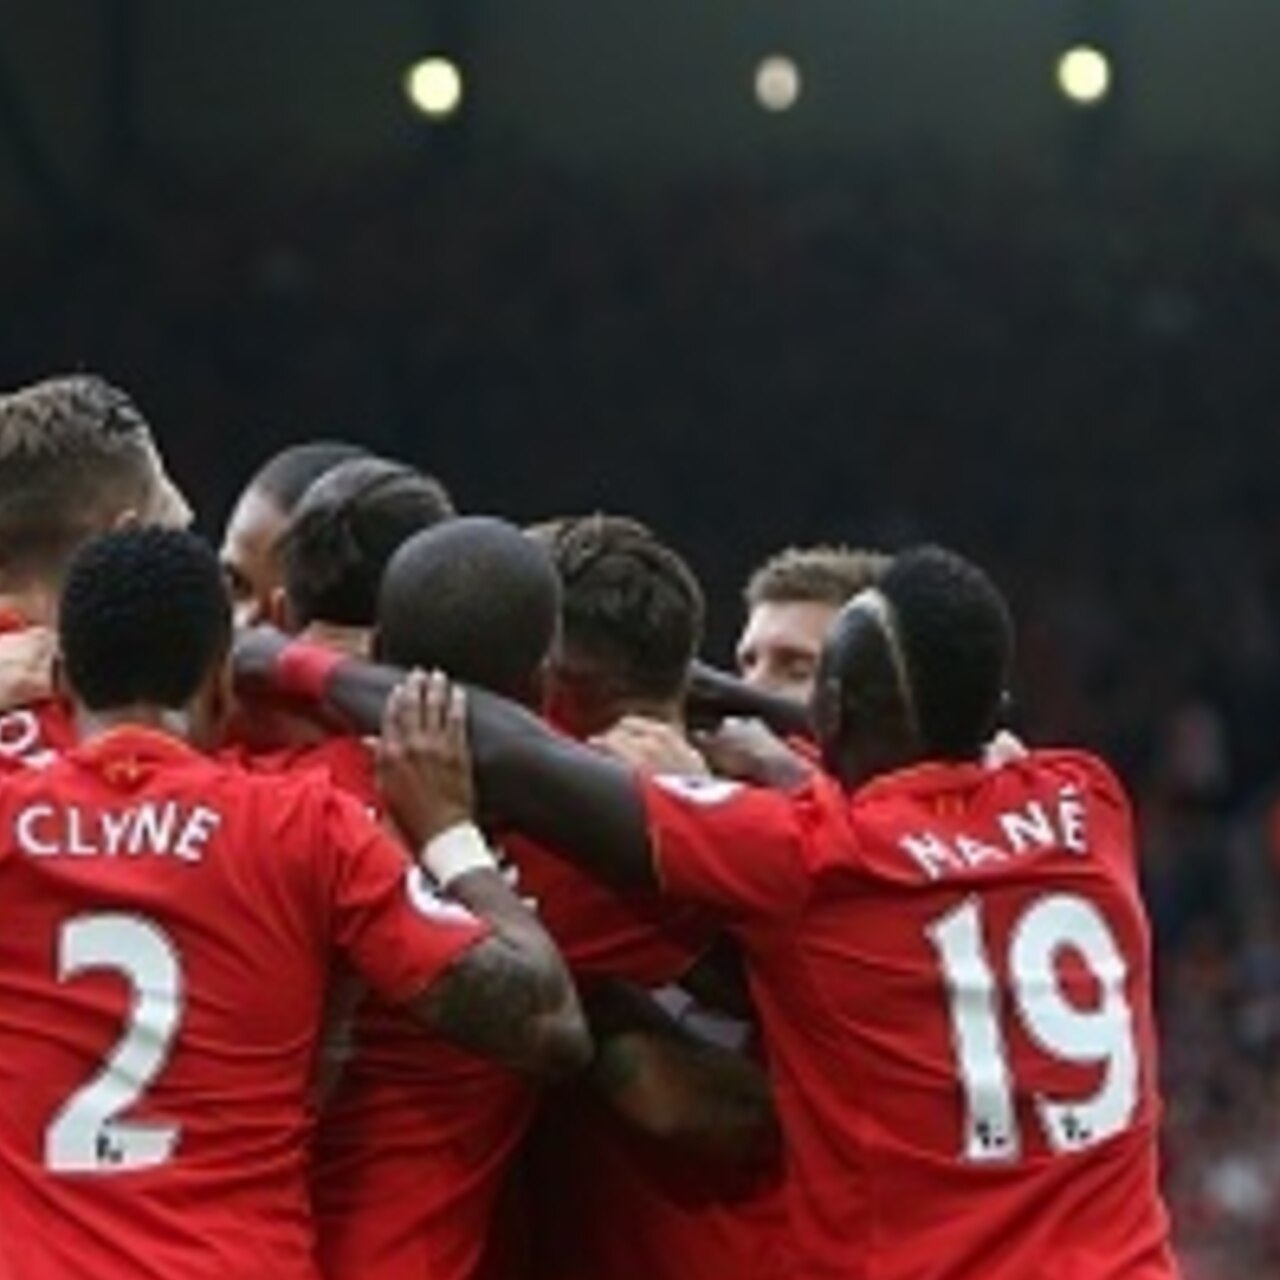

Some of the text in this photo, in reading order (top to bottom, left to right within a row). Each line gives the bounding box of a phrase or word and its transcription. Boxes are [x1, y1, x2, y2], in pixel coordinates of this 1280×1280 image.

[17, 801, 222, 860] CLYNE
[43, 911, 183, 1172] 2
[924, 890, 1140, 1164] 19
